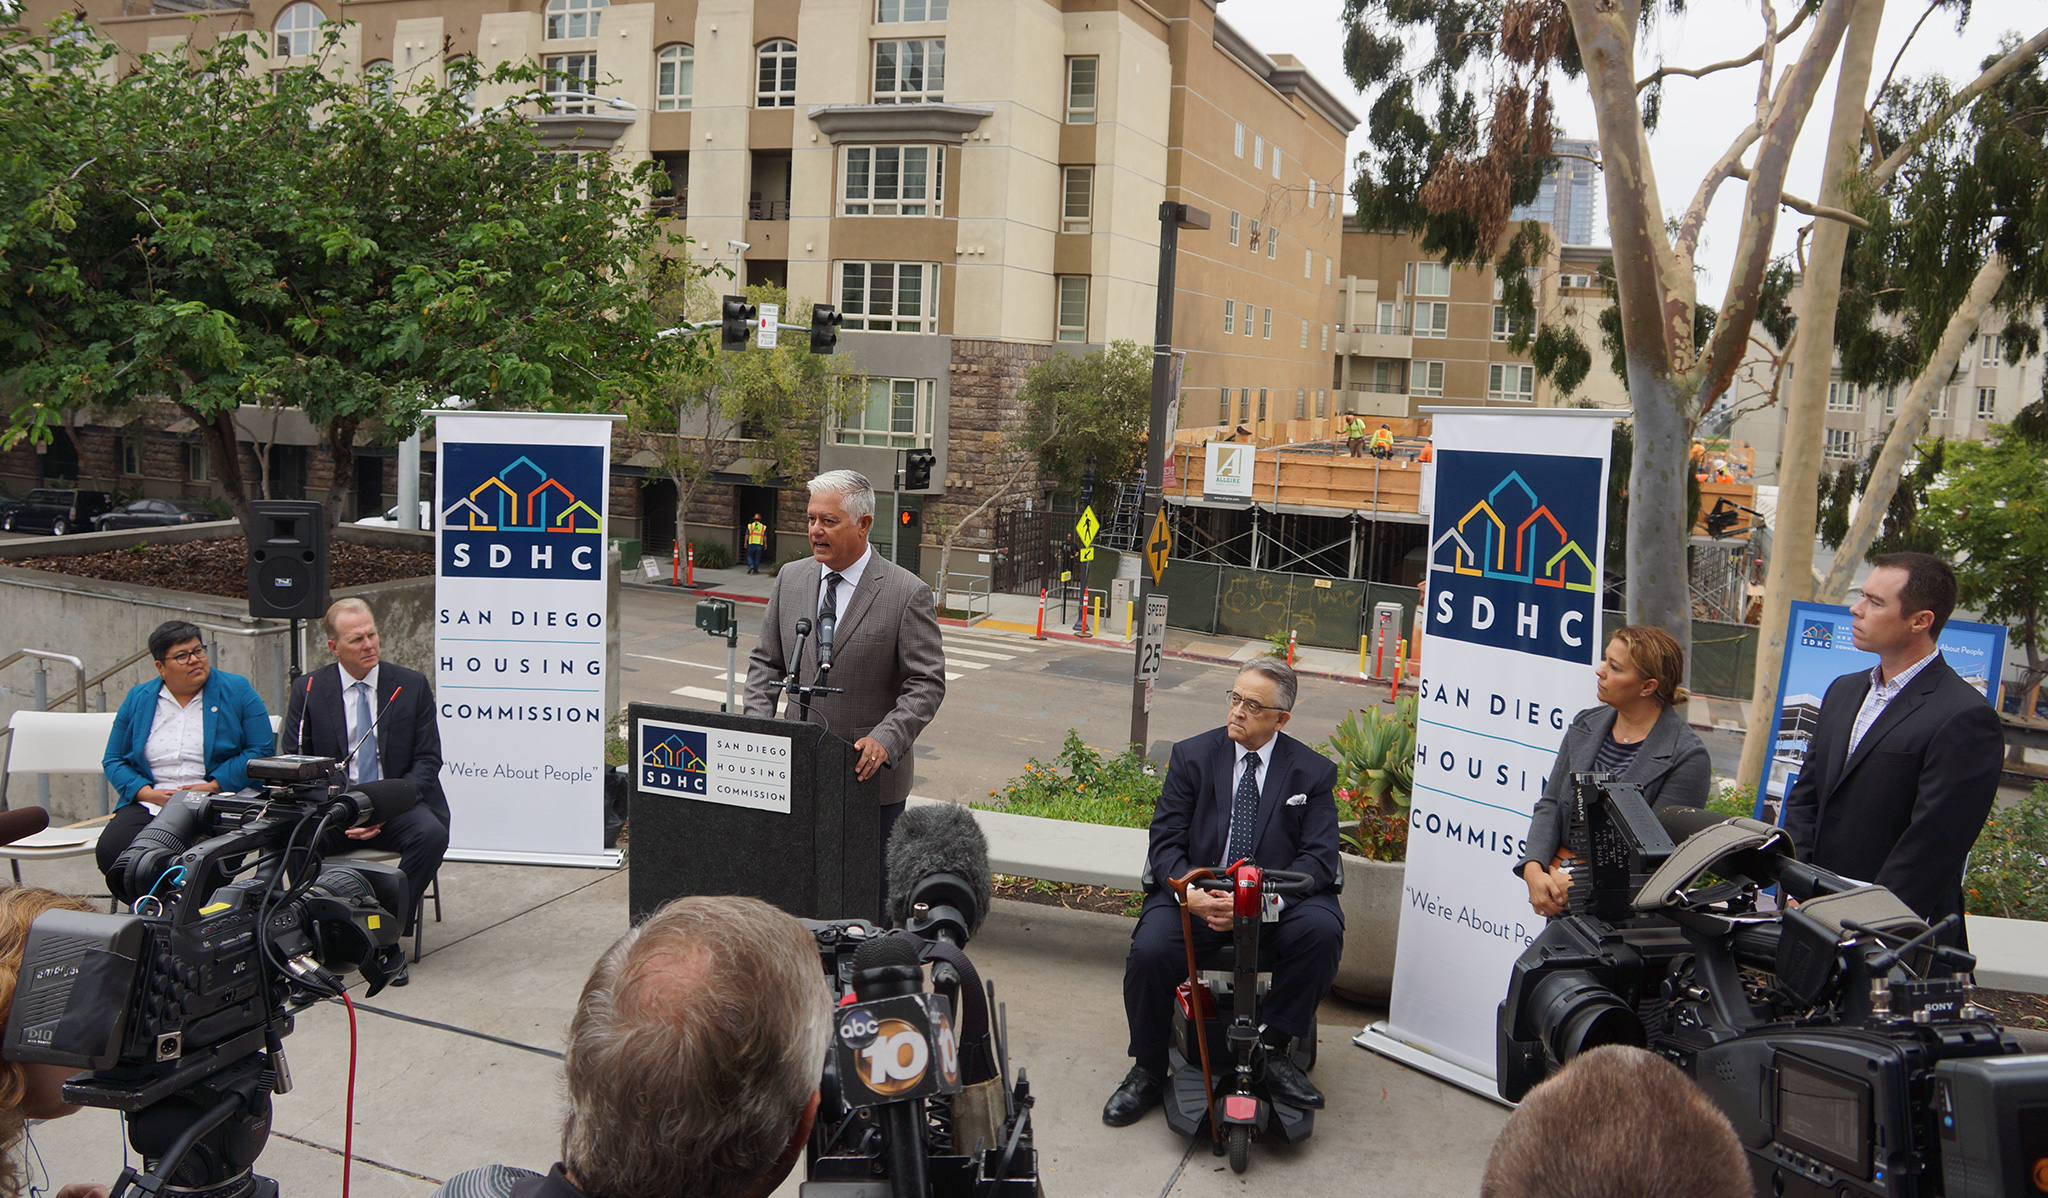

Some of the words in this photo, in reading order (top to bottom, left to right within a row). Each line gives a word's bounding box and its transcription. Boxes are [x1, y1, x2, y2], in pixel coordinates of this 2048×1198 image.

[452, 543, 593, 571] SDHC
[440, 609, 492, 625] SAN
[511, 611, 602, 628] DIEGO
[1147, 603, 1167, 617] SPEED
[1435, 590, 1584, 648] SDHC
[1147, 623, 1163, 636] LIMIT
[1802, 638, 1831, 648] SDHC
[1940, 643, 1961, 653] About
[1960, 645, 1985, 657] People
[440, 656, 601, 676] HOUSING
[1141, 643, 1162, 674] 25
[441, 703, 600, 723] COMMISSION
[1420, 679, 1470, 709] SAN
[1489, 693, 1564, 731] DIEG
[717, 740, 740, 751] SAN
[746, 744, 787, 757] DIEGO
[493, 763, 539, 780] About
[544, 764, 599, 785] People"
[717, 762, 786, 780] HOUSING
[1416, 743, 1549, 797] HOUSI
[646, 771, 704, 791] SDHC
[716, 785, 786, 802] COMMISSION
[1576, 786, 1585, 822] zylight
[1411, 808, 1527, 861] COMMISS
[1404, 885, 1453, 921] "We're
[1457, 905, 1510, 941] About
[232, 961, 246, 974] JVC
[1924, 1002, 1954, 1012] SONY
[28, 1028, 53, 1041] DIO
[839, 1014, 879, 1039] abc
[861, 1031, 929, 1085] 10
[938, 1027, 957, 1074] 10
